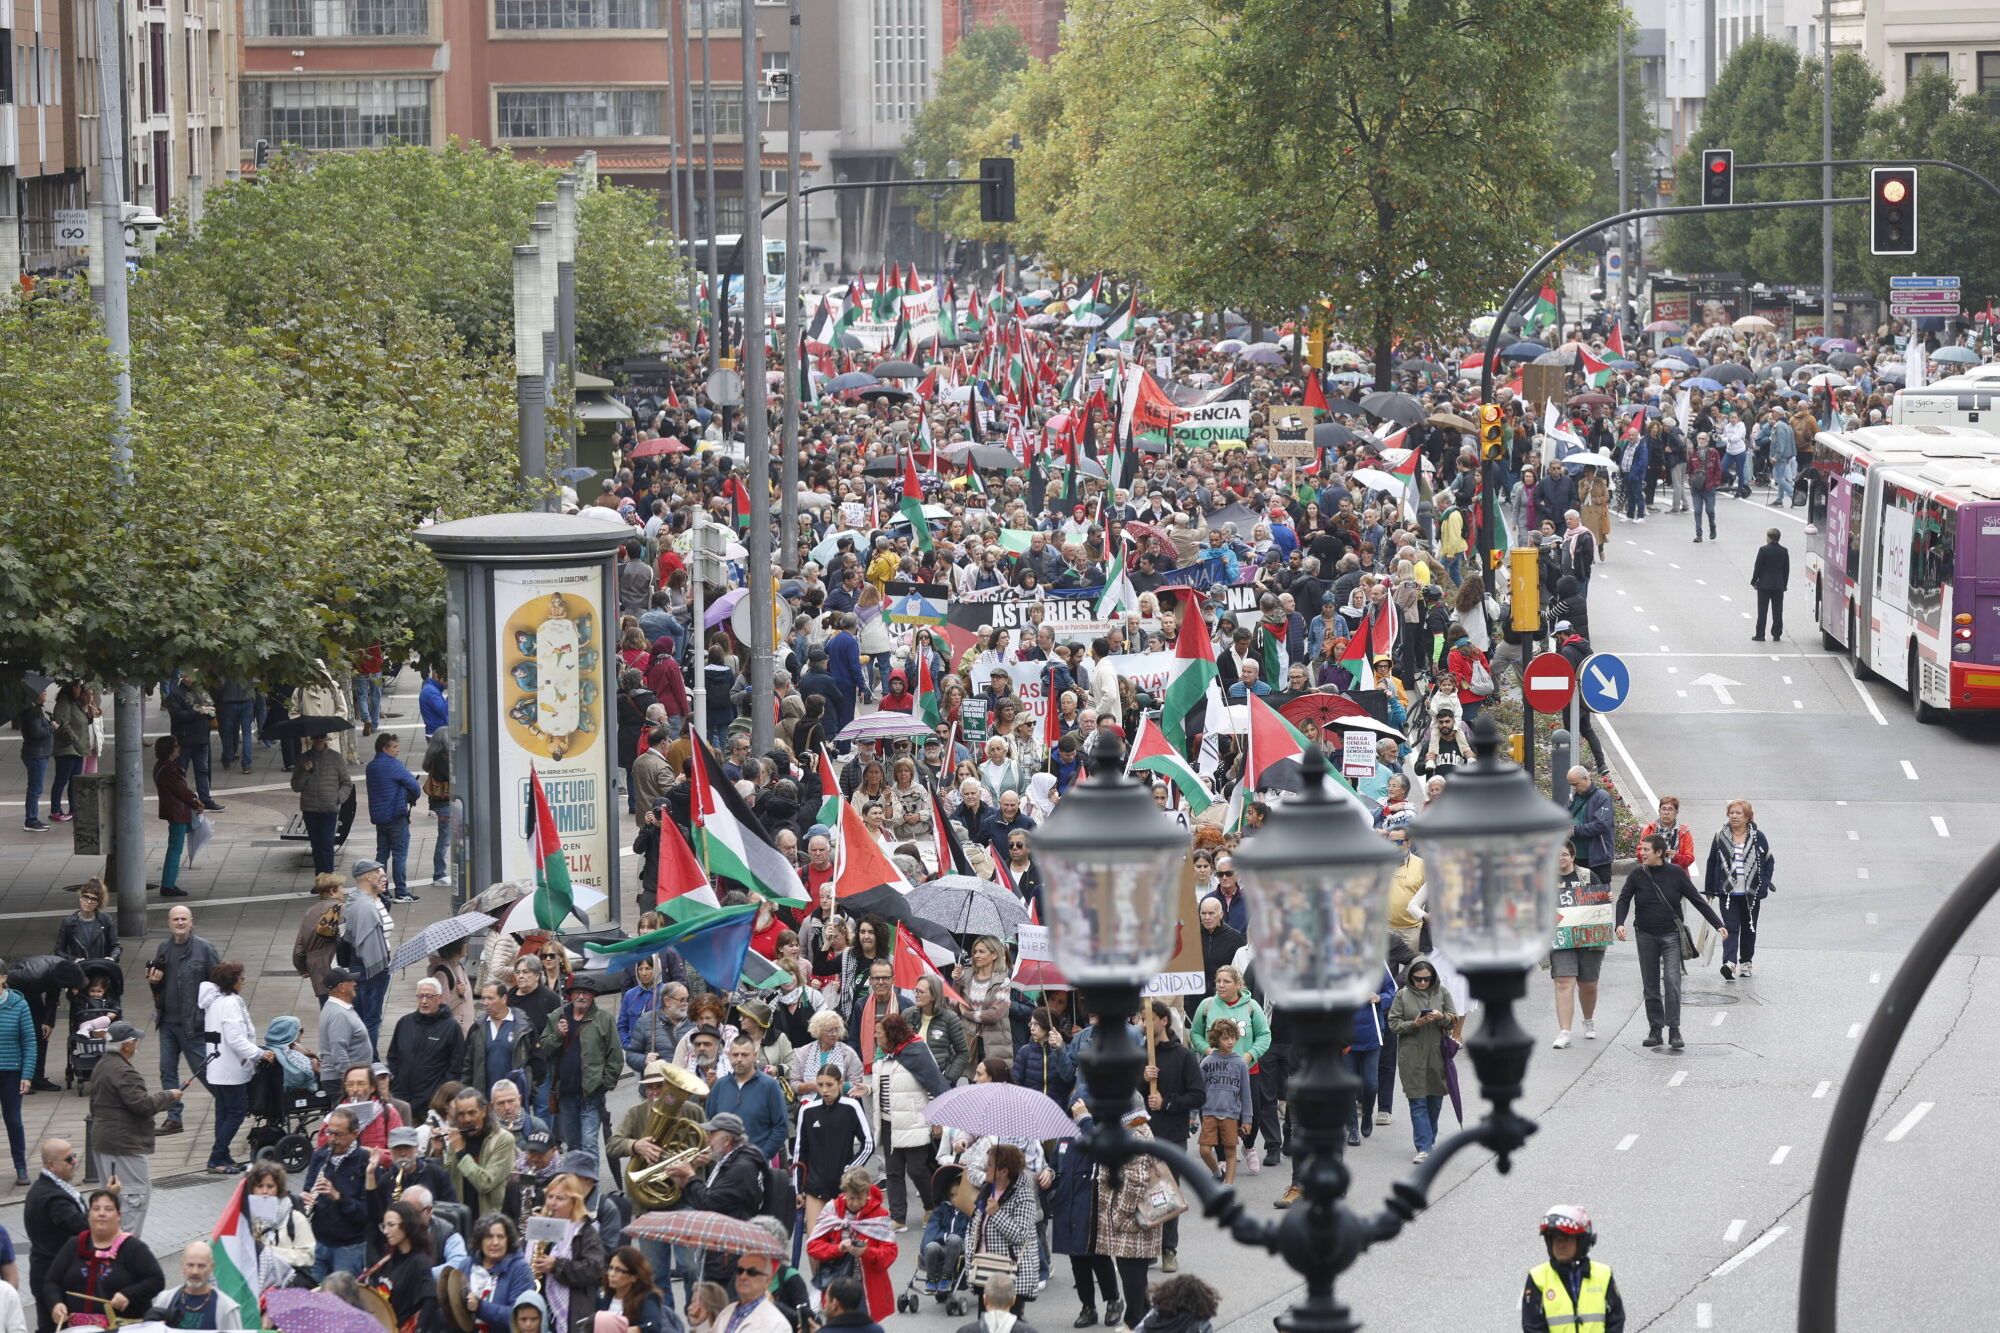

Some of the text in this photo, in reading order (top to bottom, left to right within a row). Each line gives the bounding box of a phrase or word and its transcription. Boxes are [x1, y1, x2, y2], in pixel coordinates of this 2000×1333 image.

[1972, 394, 1979, 409] 1
[544, 779, 595, 803] REFUGIO
[1021, 941, 1050, 952] LIBR
